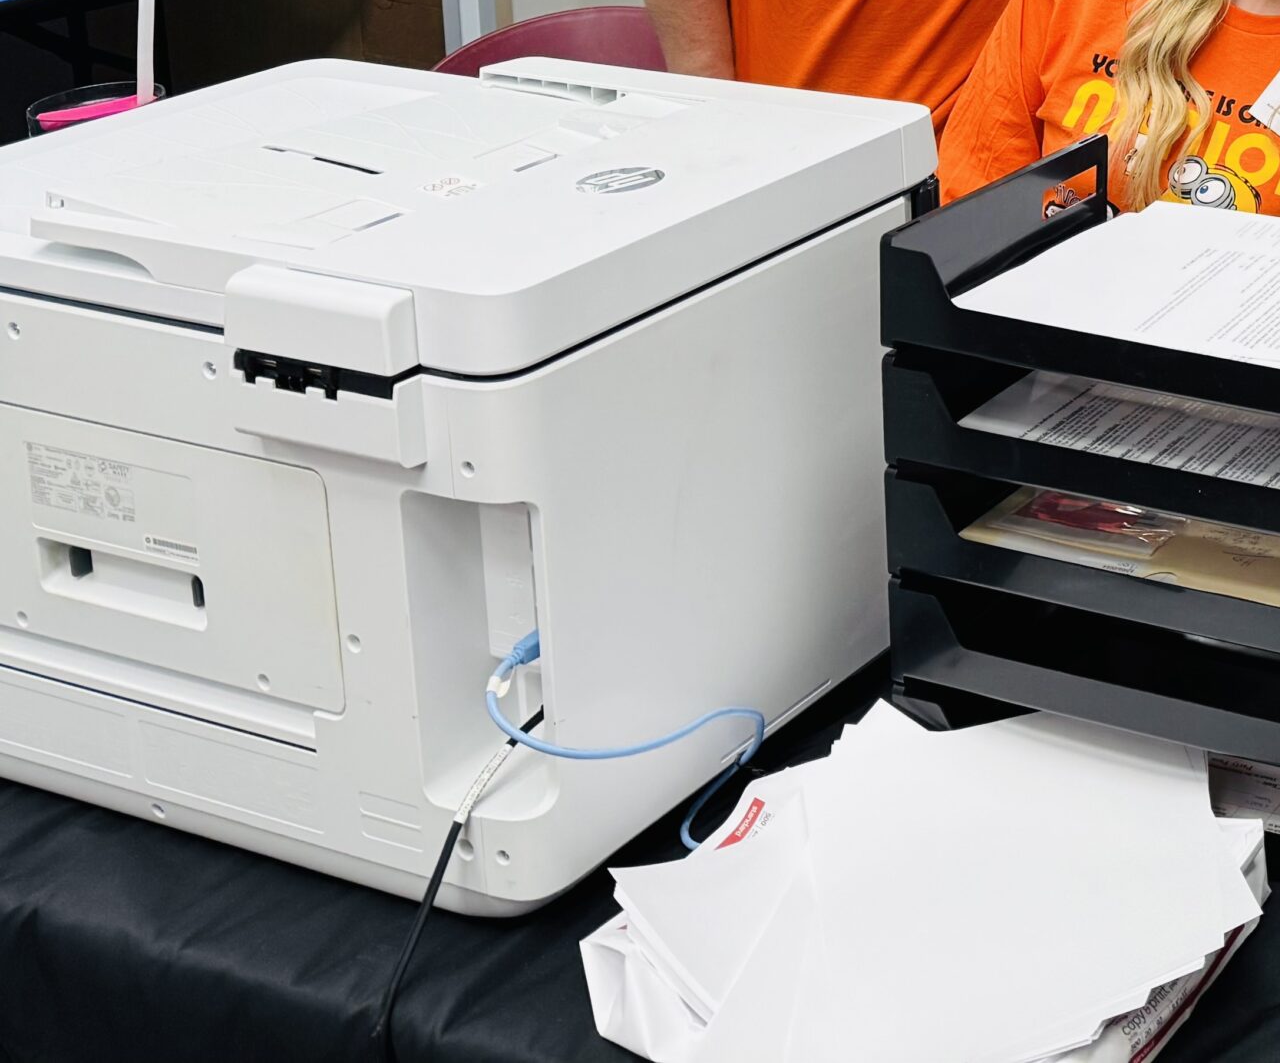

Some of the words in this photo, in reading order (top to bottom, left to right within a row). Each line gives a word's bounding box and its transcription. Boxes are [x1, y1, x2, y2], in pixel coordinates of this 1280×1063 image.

[1092, 53, 1118, 78] YO
[1216, 94, 1236, 117] IS
[1121, 1009, 1146, 1036] copy
[1148, 984, 1172, 1012] print
